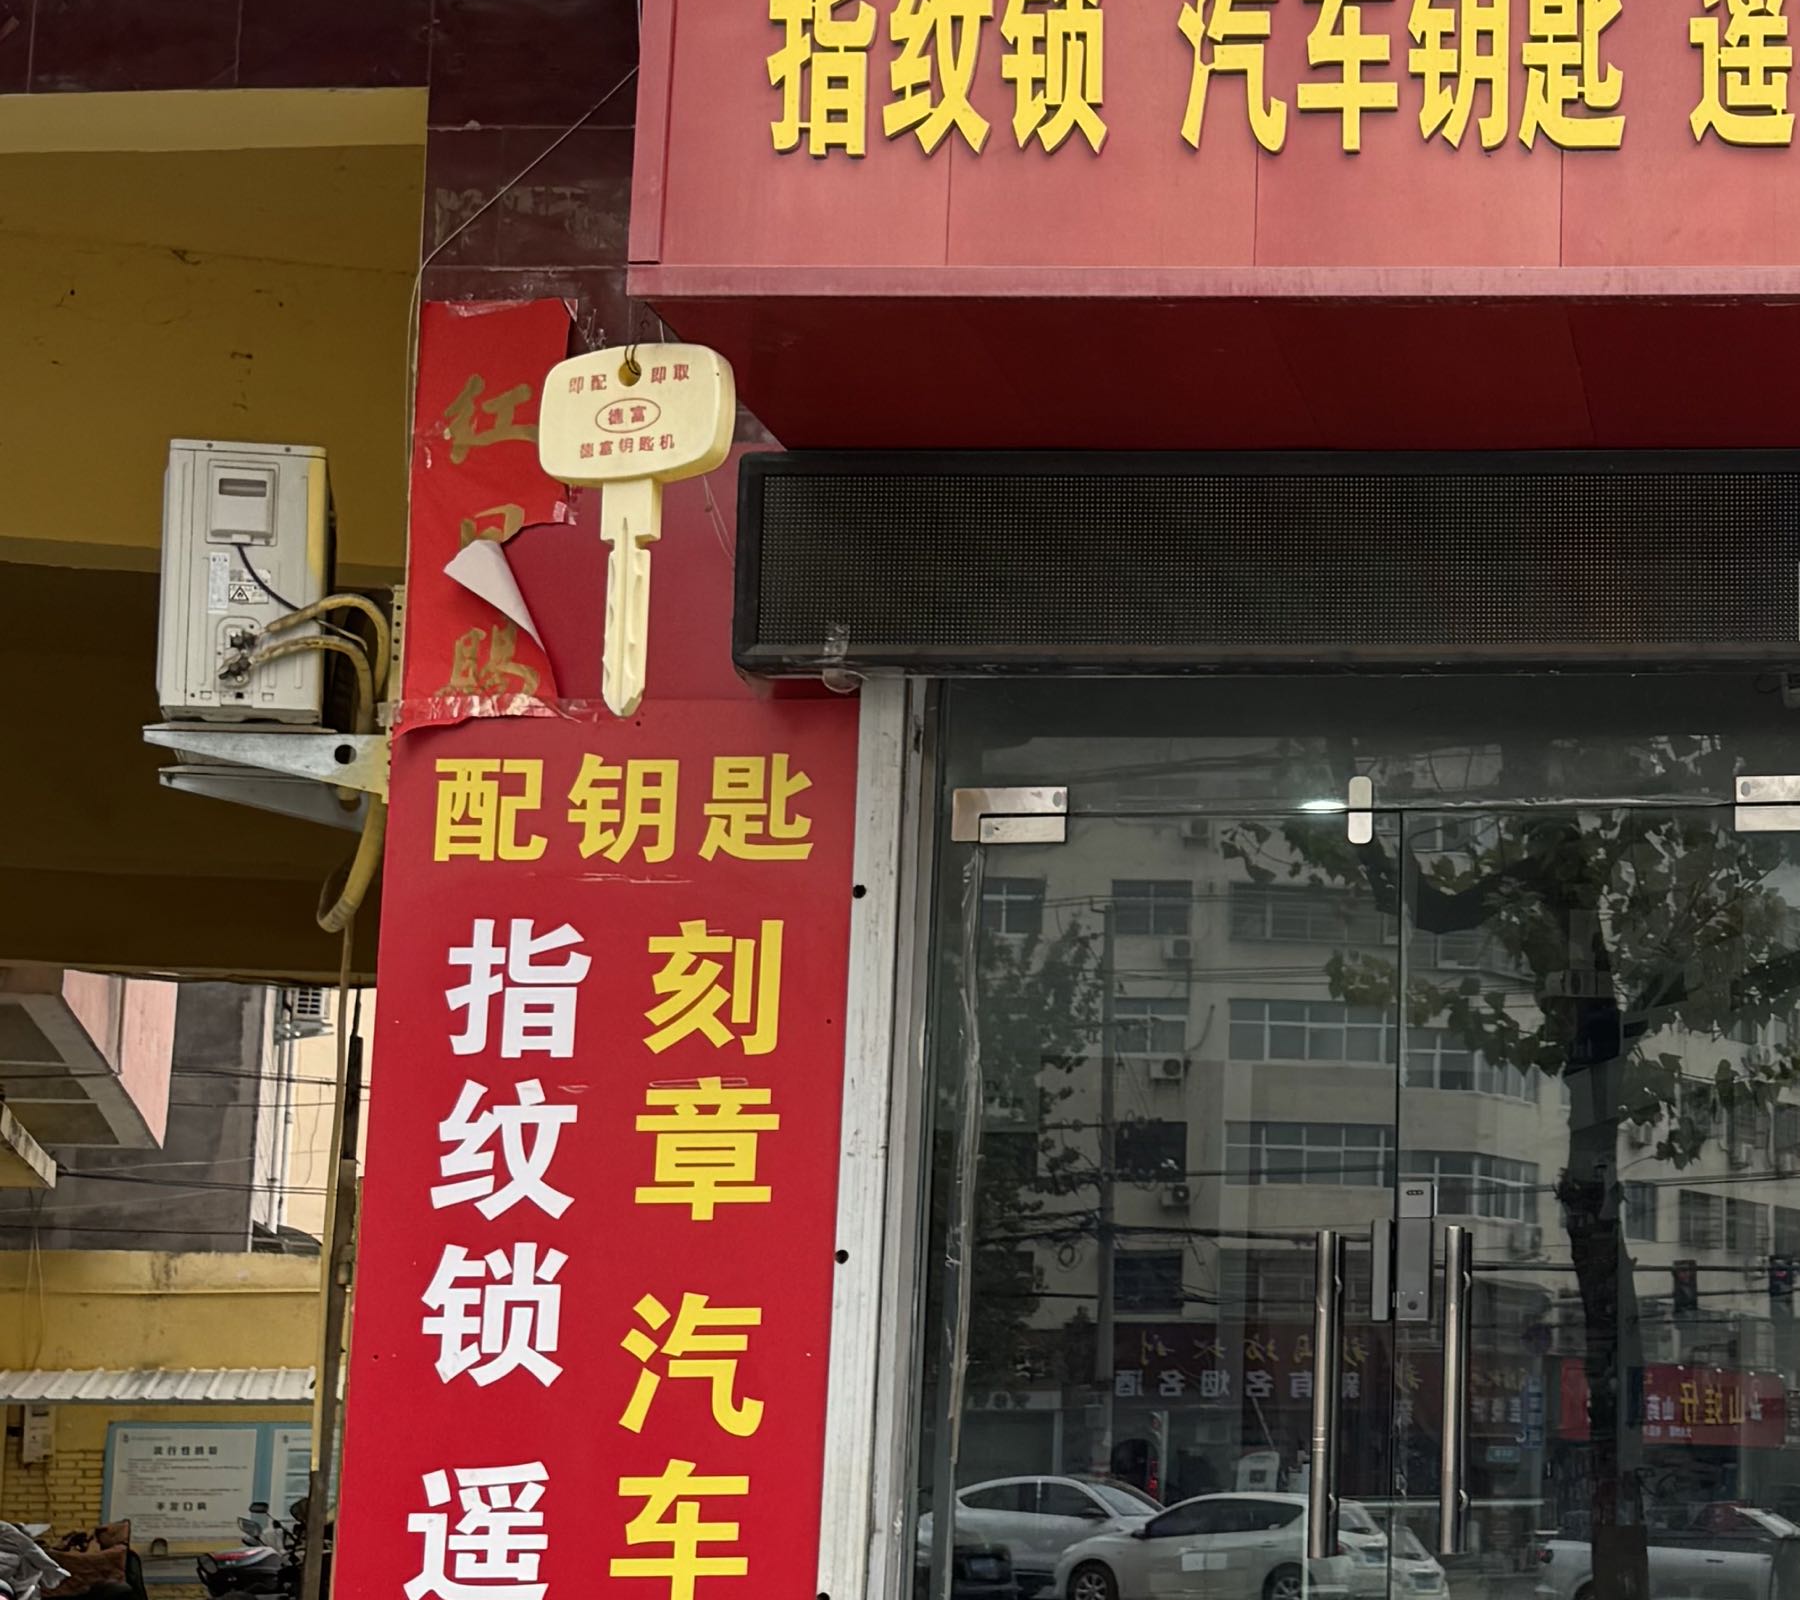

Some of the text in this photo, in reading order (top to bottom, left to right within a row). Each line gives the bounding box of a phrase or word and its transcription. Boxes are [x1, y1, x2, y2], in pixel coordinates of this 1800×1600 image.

[433, 754, 813, 863] 配钥匙
[422, 917, 591, 1388] 指纹锁
[634, 920, 783, 1222] 刻章
